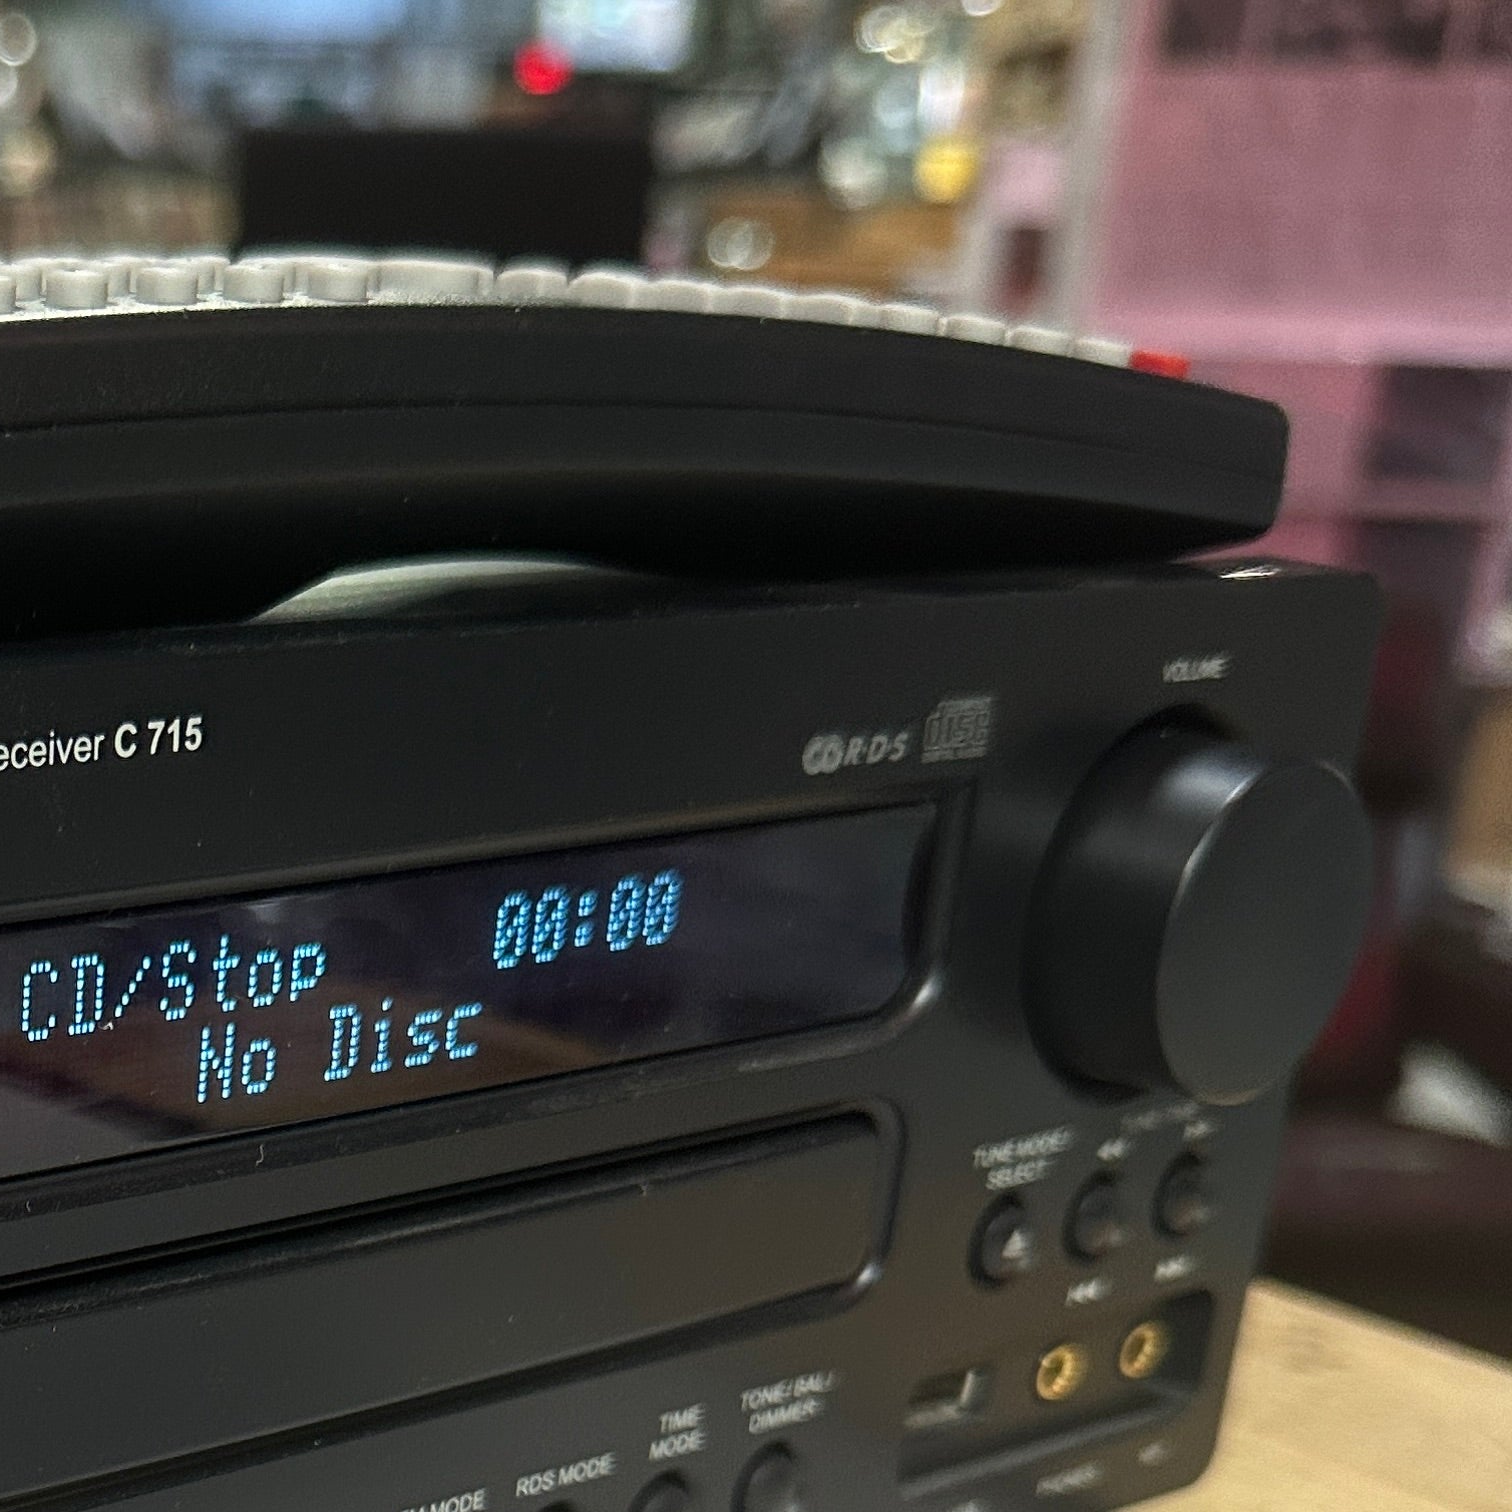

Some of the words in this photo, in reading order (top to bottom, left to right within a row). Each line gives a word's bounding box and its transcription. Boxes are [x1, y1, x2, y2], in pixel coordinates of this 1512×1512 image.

[113, 722, 137, 759] C
[147, 716, 204, 754] 715
[20, 934, 327, 1042] CD/Stop
[493, 868, 683, 969] 00:00
[197, 1022, 278, 1104] No
[324, 997, 483, 1082] Disc
[648, 1428, 706, 1461] MODE
[515, 1471, 554, 1498] RDS
[558, 1454, 617, 1488] MODE
